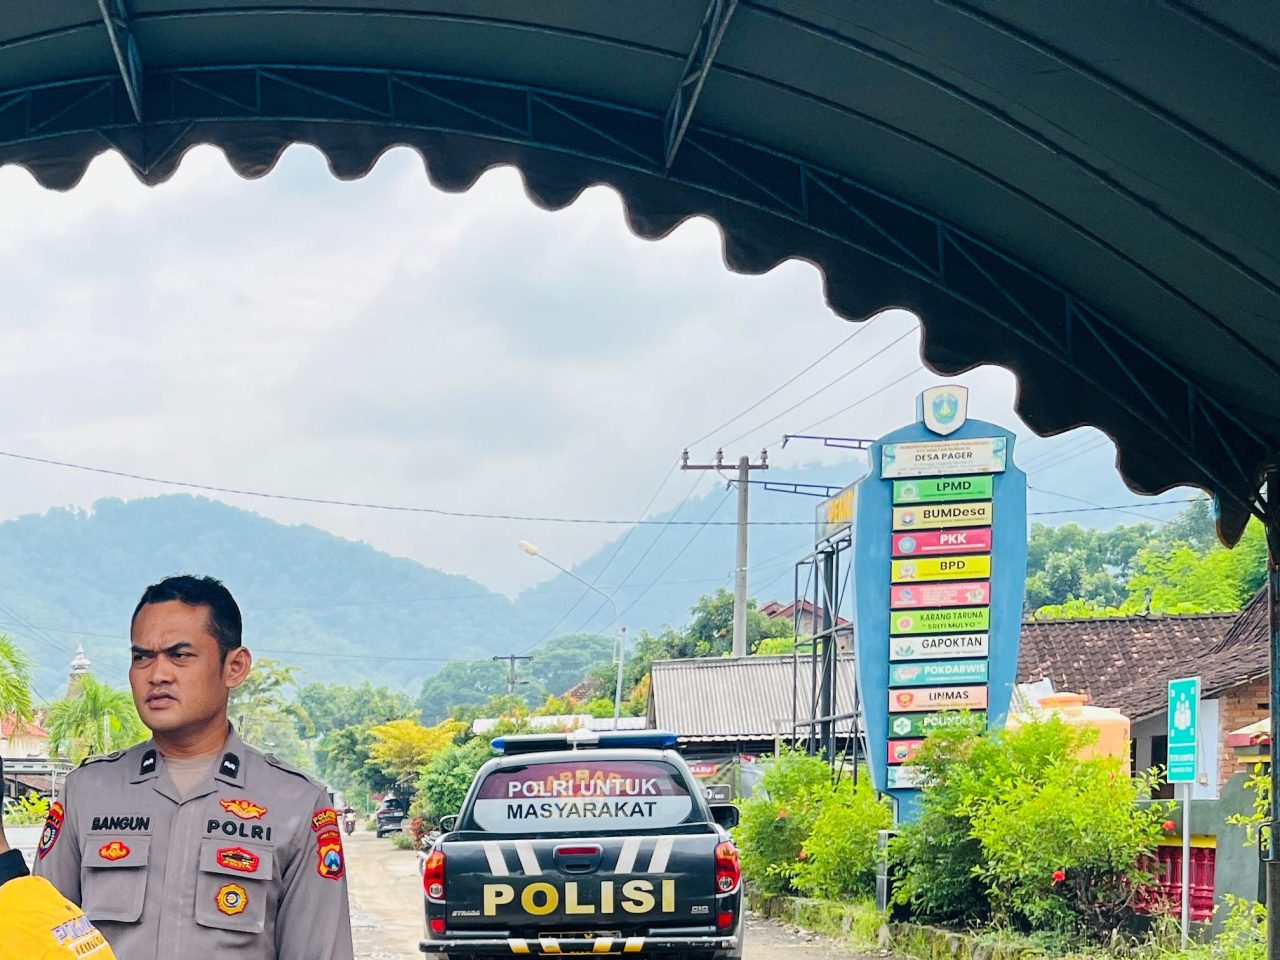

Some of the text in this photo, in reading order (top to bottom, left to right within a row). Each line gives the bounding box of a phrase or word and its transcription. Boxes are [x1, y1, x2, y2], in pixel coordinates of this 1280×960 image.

[915, 452, 973, 462] DESA PAGER
[936, 481, 971, 492] LPMD
[923, 508, 985, 519] BUMDesa
[940, 533, 967, 545] PKK
[940, 561, 966, 571] BPD
[920, 611, 983, 622] KARANG TARUNA
[948, 621, 976, 629] MULYO
[921, 637, 982, 649] GAPOKTAN
[924, 664, 986, 675] POKDARWIS
[929, 691, 969, 701] LINMAS
[508, 778, 657, 798] POLRI UNTUK
[507, 801, 657, 820] MASYARAKAT
[91, 816, 150, 831] BANGUN
[207, 820, 272, 841] POLRI
[483, 879, 675, 917] POLISI
